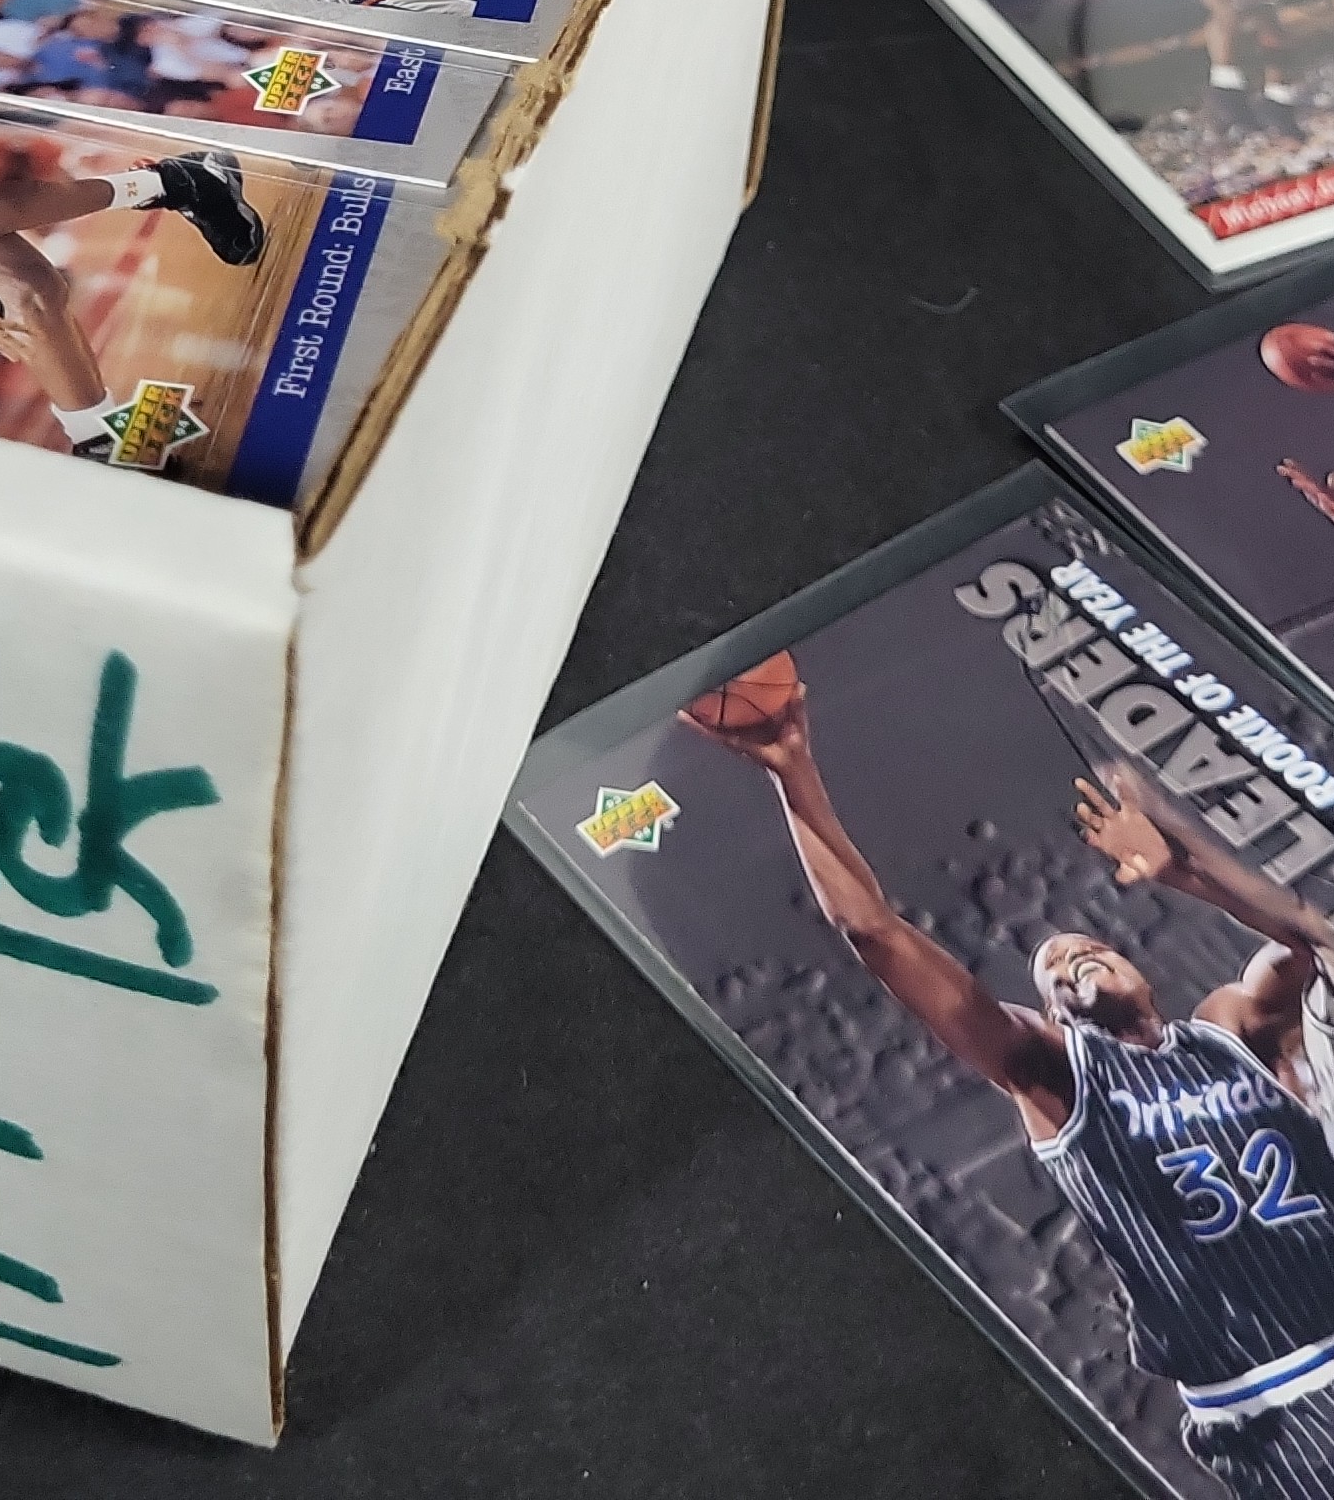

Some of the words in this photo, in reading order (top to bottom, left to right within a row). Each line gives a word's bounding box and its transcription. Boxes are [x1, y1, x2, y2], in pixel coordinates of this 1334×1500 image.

[262, 51, 301, 109] UPPER
[281, 54, 321, 111] DECK
[330, 176, 376, 237] Bulls
[297, 242, 356, 330] Round:
[273, 331, 324, 399] First
[116, 384, 164, 463] UPPER
[1049, 560, 1139, 632] YEAR
[1118, 621, 1194, 679] THE
[1173, 672, 1237, 713] OF
[1155, 1128, 1327, 1242] 32
